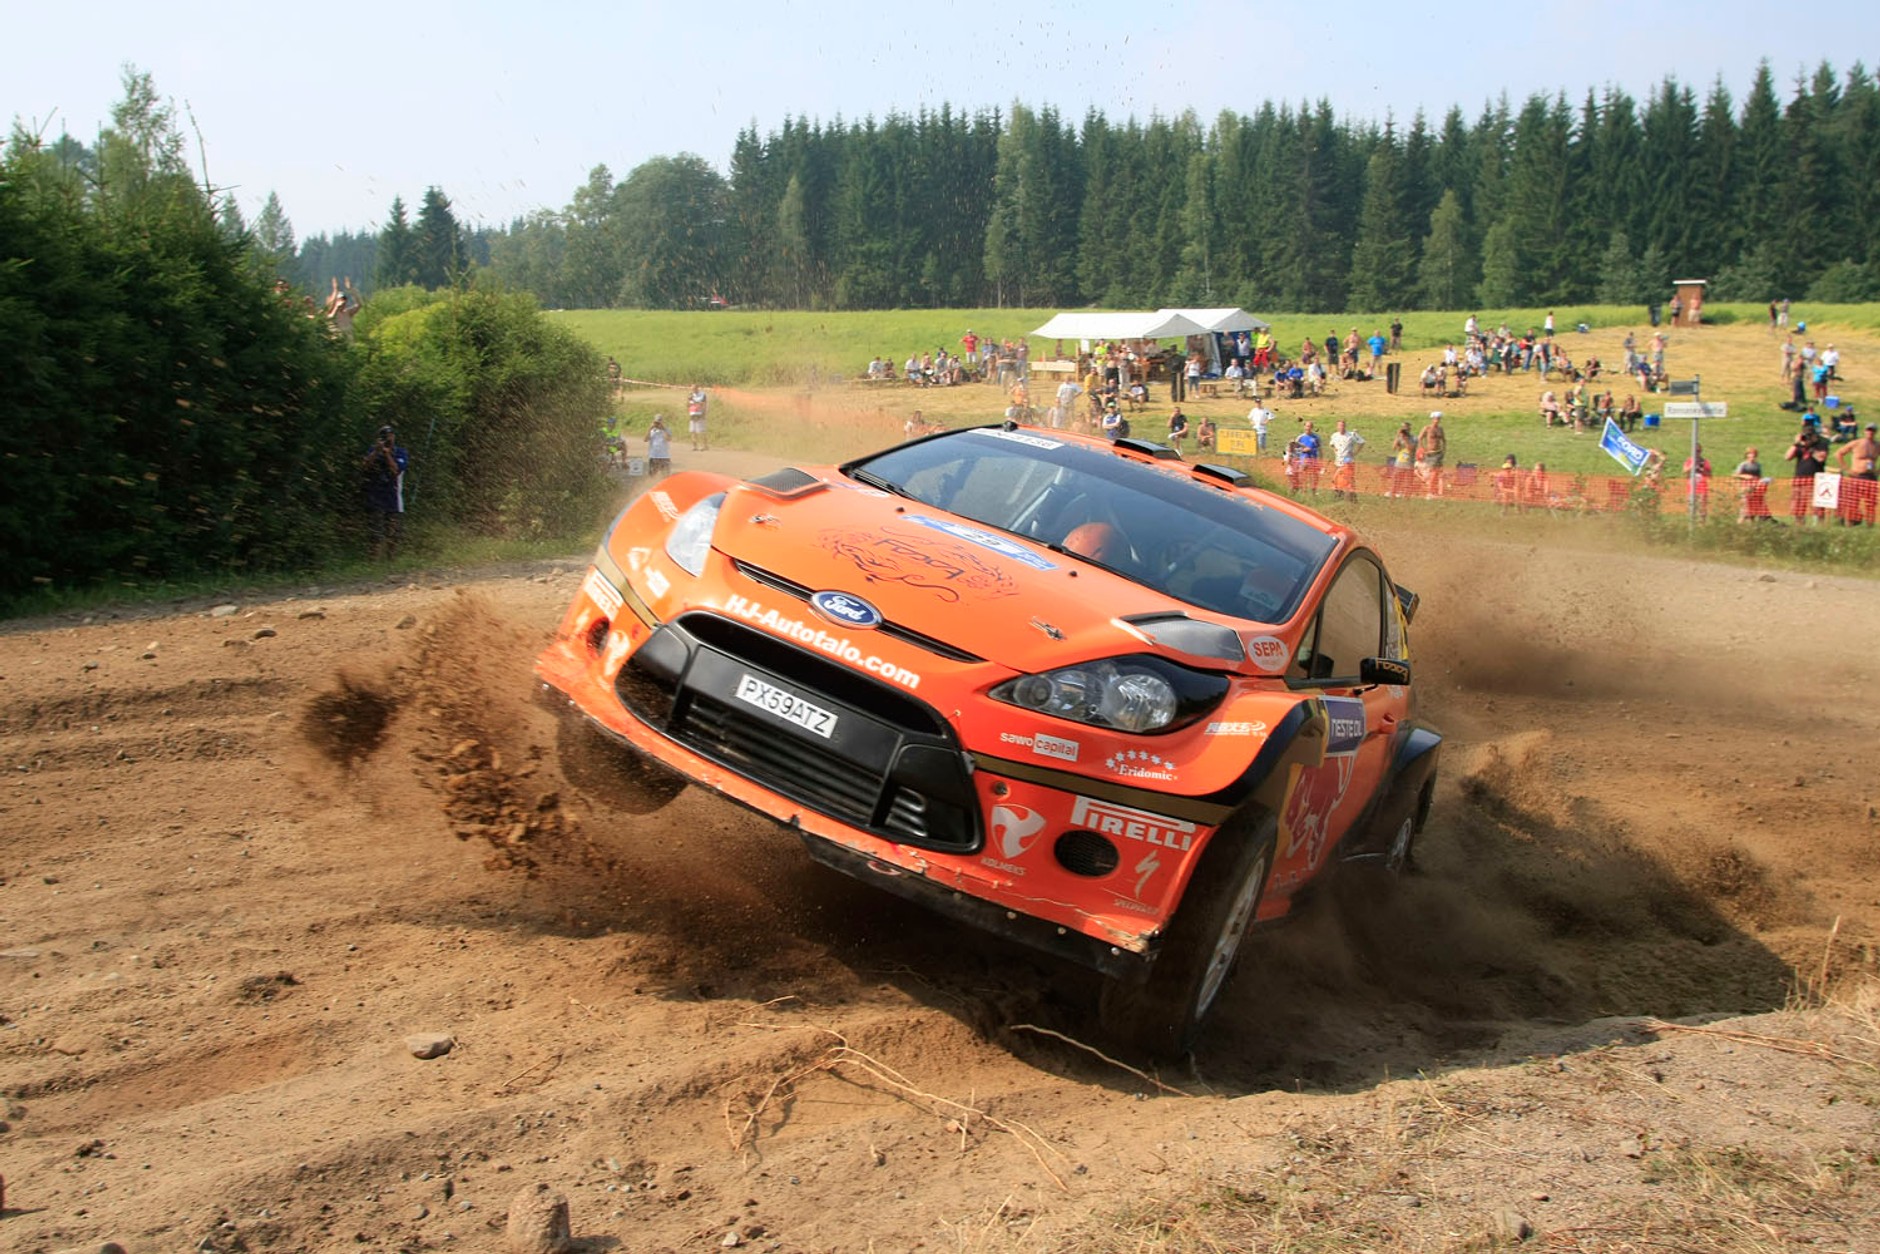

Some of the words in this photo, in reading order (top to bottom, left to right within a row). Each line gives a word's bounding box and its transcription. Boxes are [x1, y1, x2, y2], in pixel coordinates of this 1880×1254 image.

[823, 595, 867, 620] Ford
[724, 594, 921, 690] HJ-Autotalo.com
[1253, 641, 1284, 657] SEPA
[742, 679, 831, 733] PX59ATZ
[999, 732, 1033, 747] sawo
[1036, 737, 1076, 756] capital
[1118, 764, 1173, 781] Eridomic
[1069, 795, 1196, 852] PIRELLI
